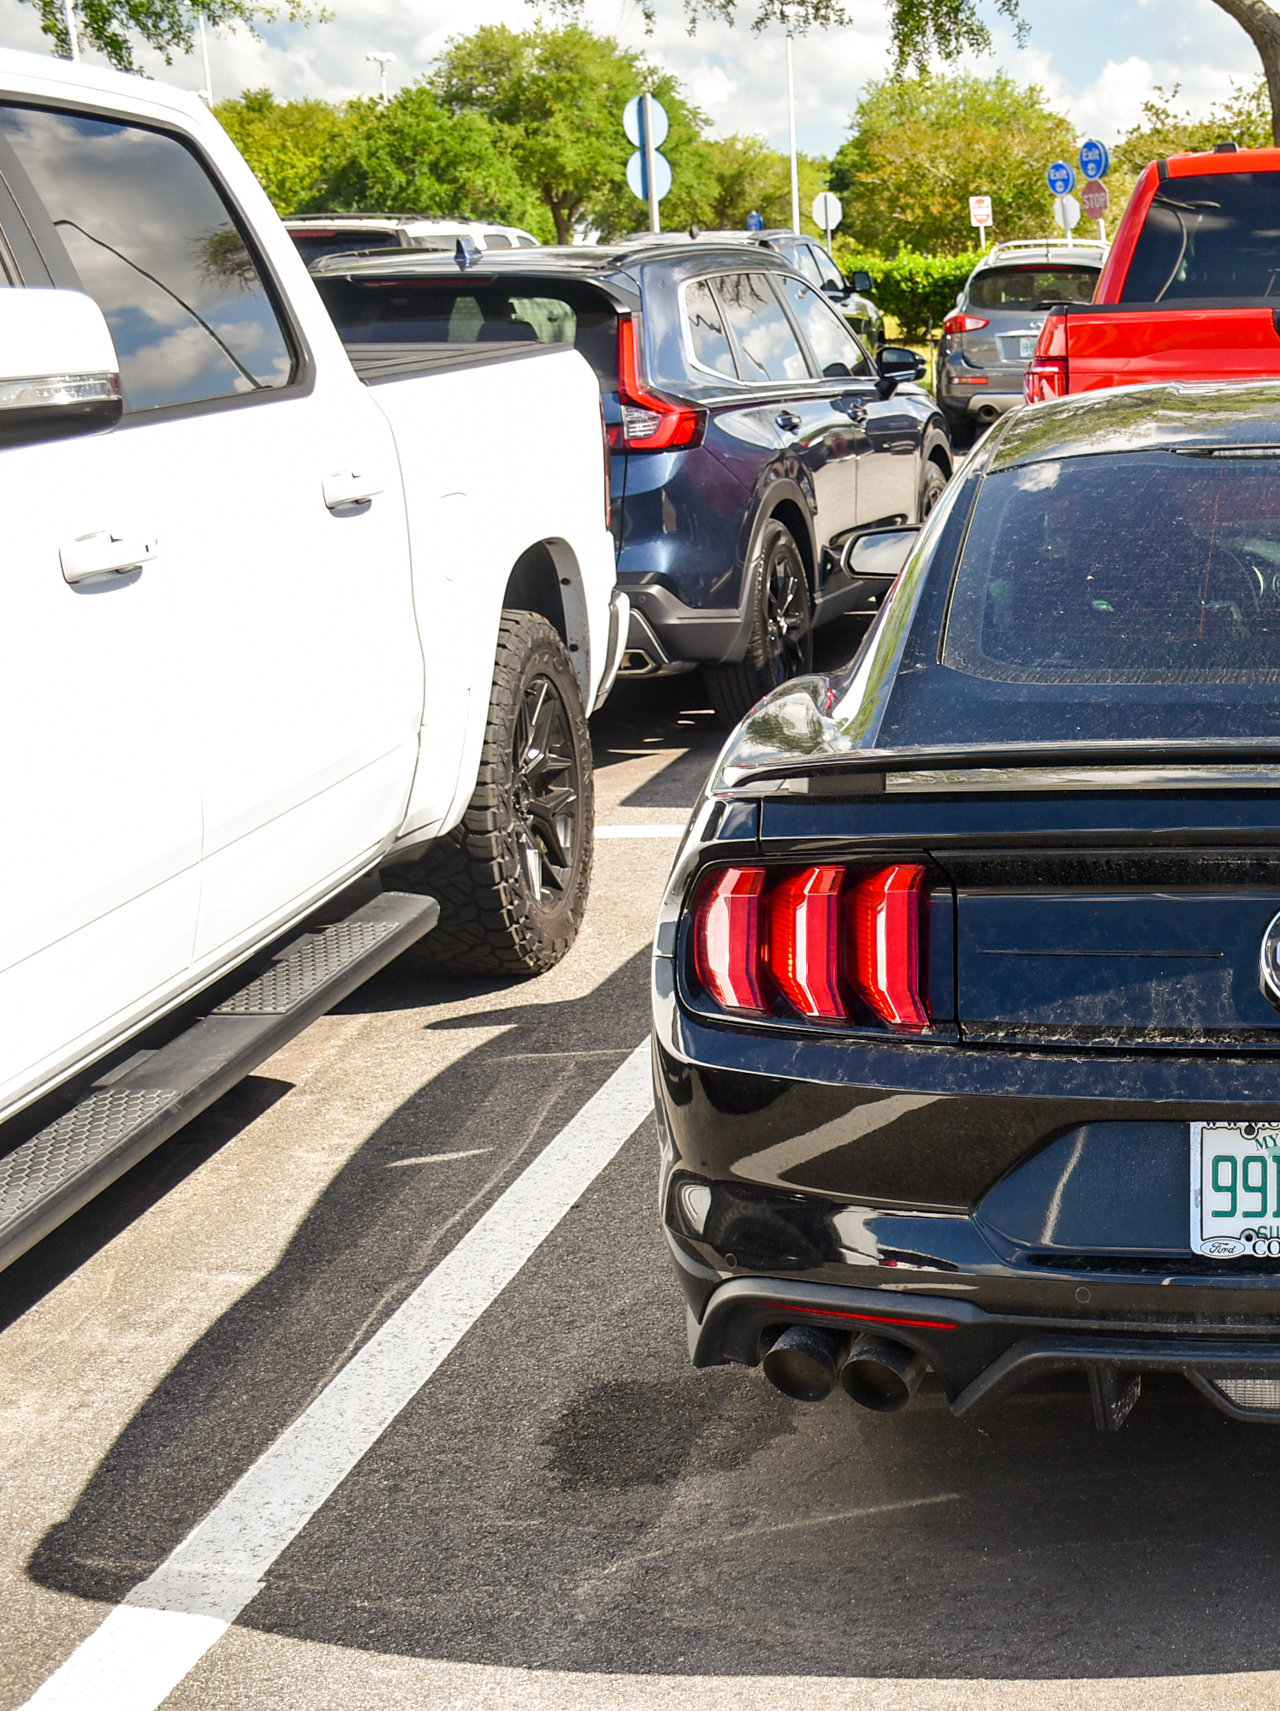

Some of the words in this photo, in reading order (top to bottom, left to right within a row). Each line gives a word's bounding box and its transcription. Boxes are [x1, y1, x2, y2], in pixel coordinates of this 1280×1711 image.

[1082, 148, 1100, 161] Exit
[1049, 168, 1068, 180] Exit
[1083, 193, 1106, 209] STOP
[1209, 1241, 1237, 1255] Ford
